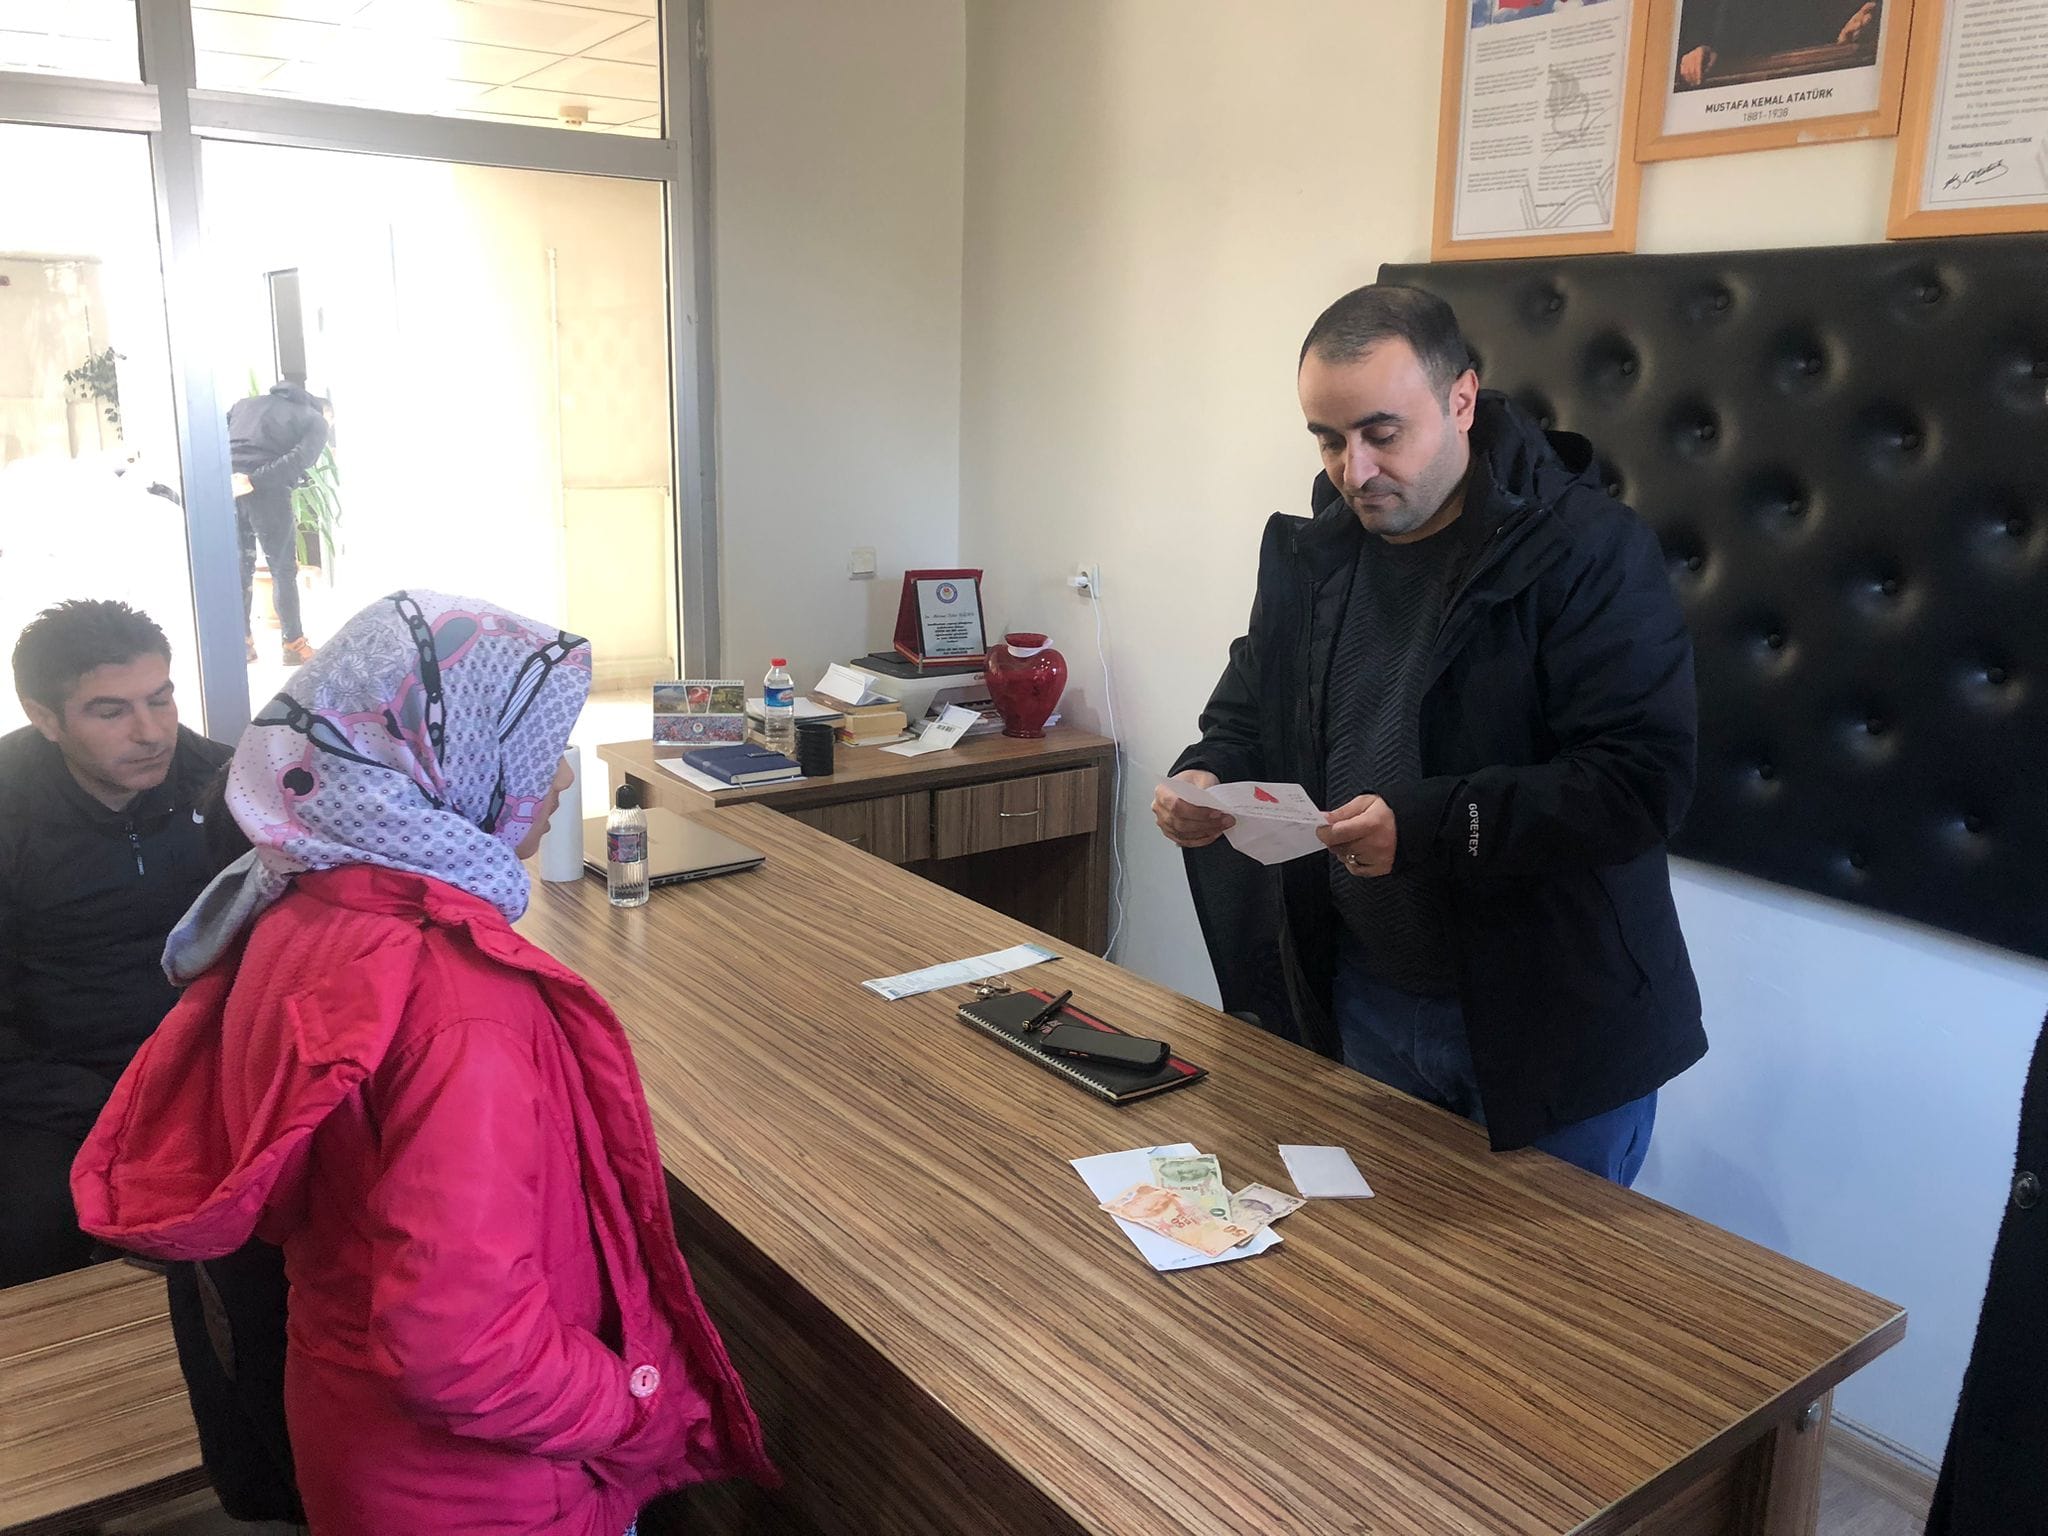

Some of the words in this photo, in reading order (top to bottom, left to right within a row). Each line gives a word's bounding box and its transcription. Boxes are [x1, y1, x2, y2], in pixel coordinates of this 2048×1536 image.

[1705, 99, 1749, 113] MUSTAFA
[1751, 95, 1784, 108] KEMAL
[1787, 88, 1833, 103] ATATÜRK
[1743, 107, 1789, 121] 1881-1938
[1223, 1225, 1247, 1237] 50
